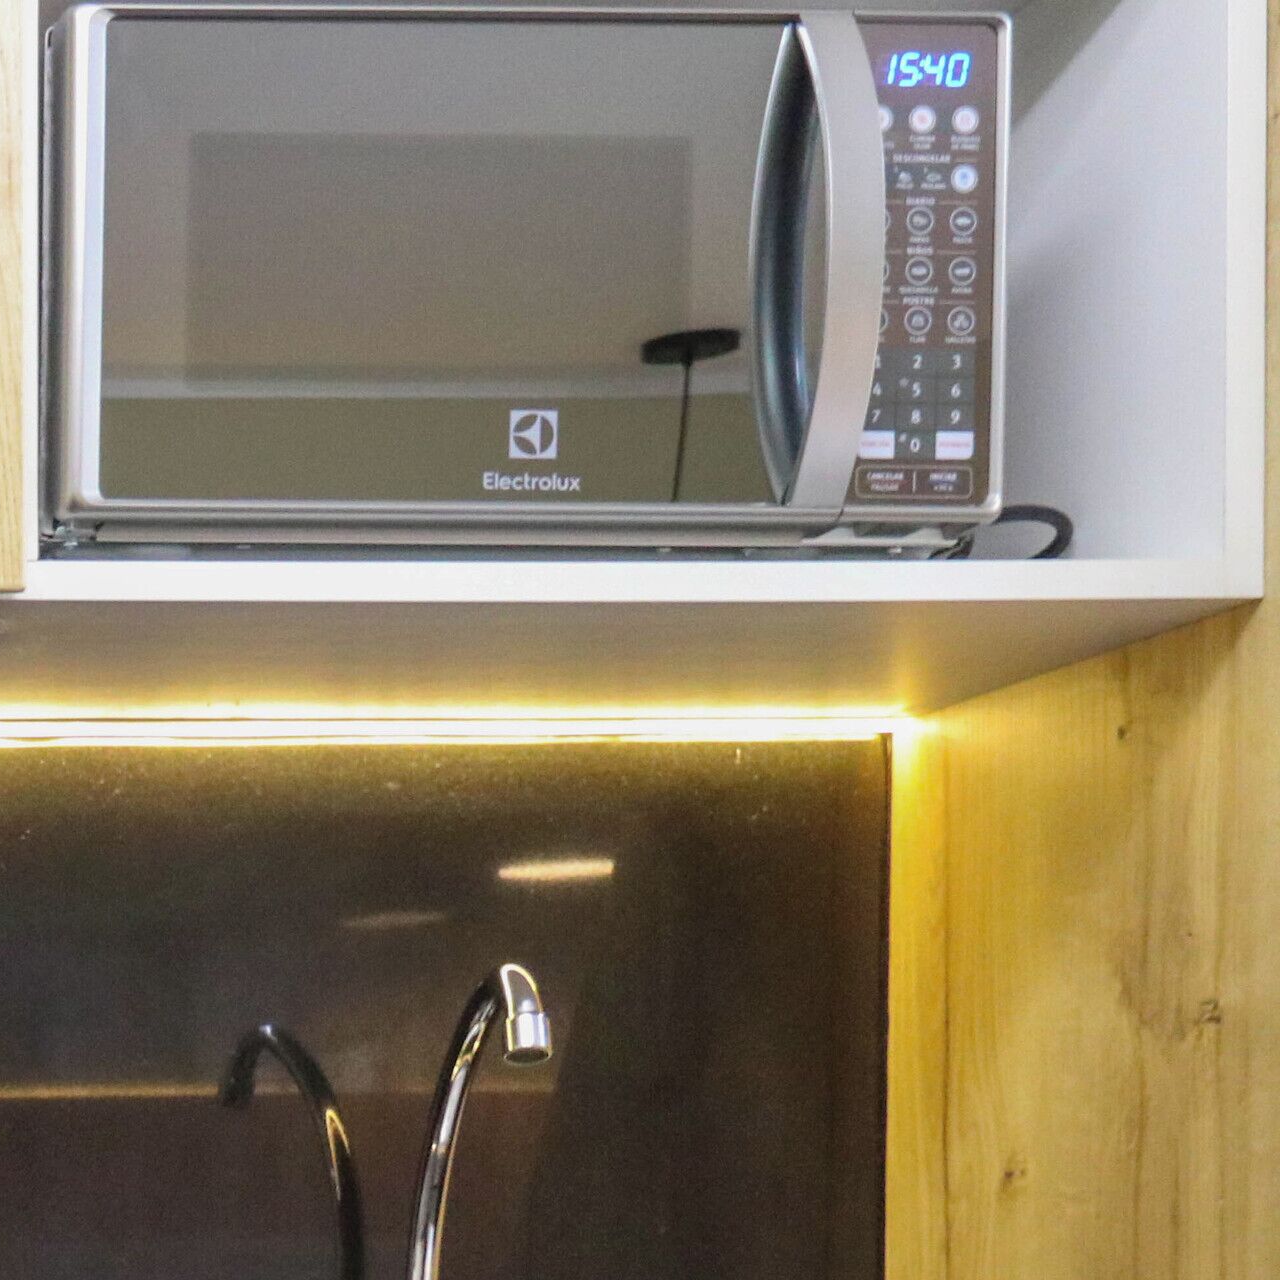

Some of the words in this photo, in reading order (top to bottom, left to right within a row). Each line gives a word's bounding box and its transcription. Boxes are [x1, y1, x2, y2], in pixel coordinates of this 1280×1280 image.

[887, 51, 971, 88] 15:40
[912, 354, 923, 370] 2
[953, 354, 962, 370] 3
[872, 382, 882, 396] 4
[912, 382, 922, 397] 5
[951, 382, 961, 398] 6
[871, 409, 881, 424] 7
[911, 409, 921, 424] 8
[951, 409, 961, 425] 9
[910, 438, 921, 453] 0
[482, 471, 581, 491] Electrolux
